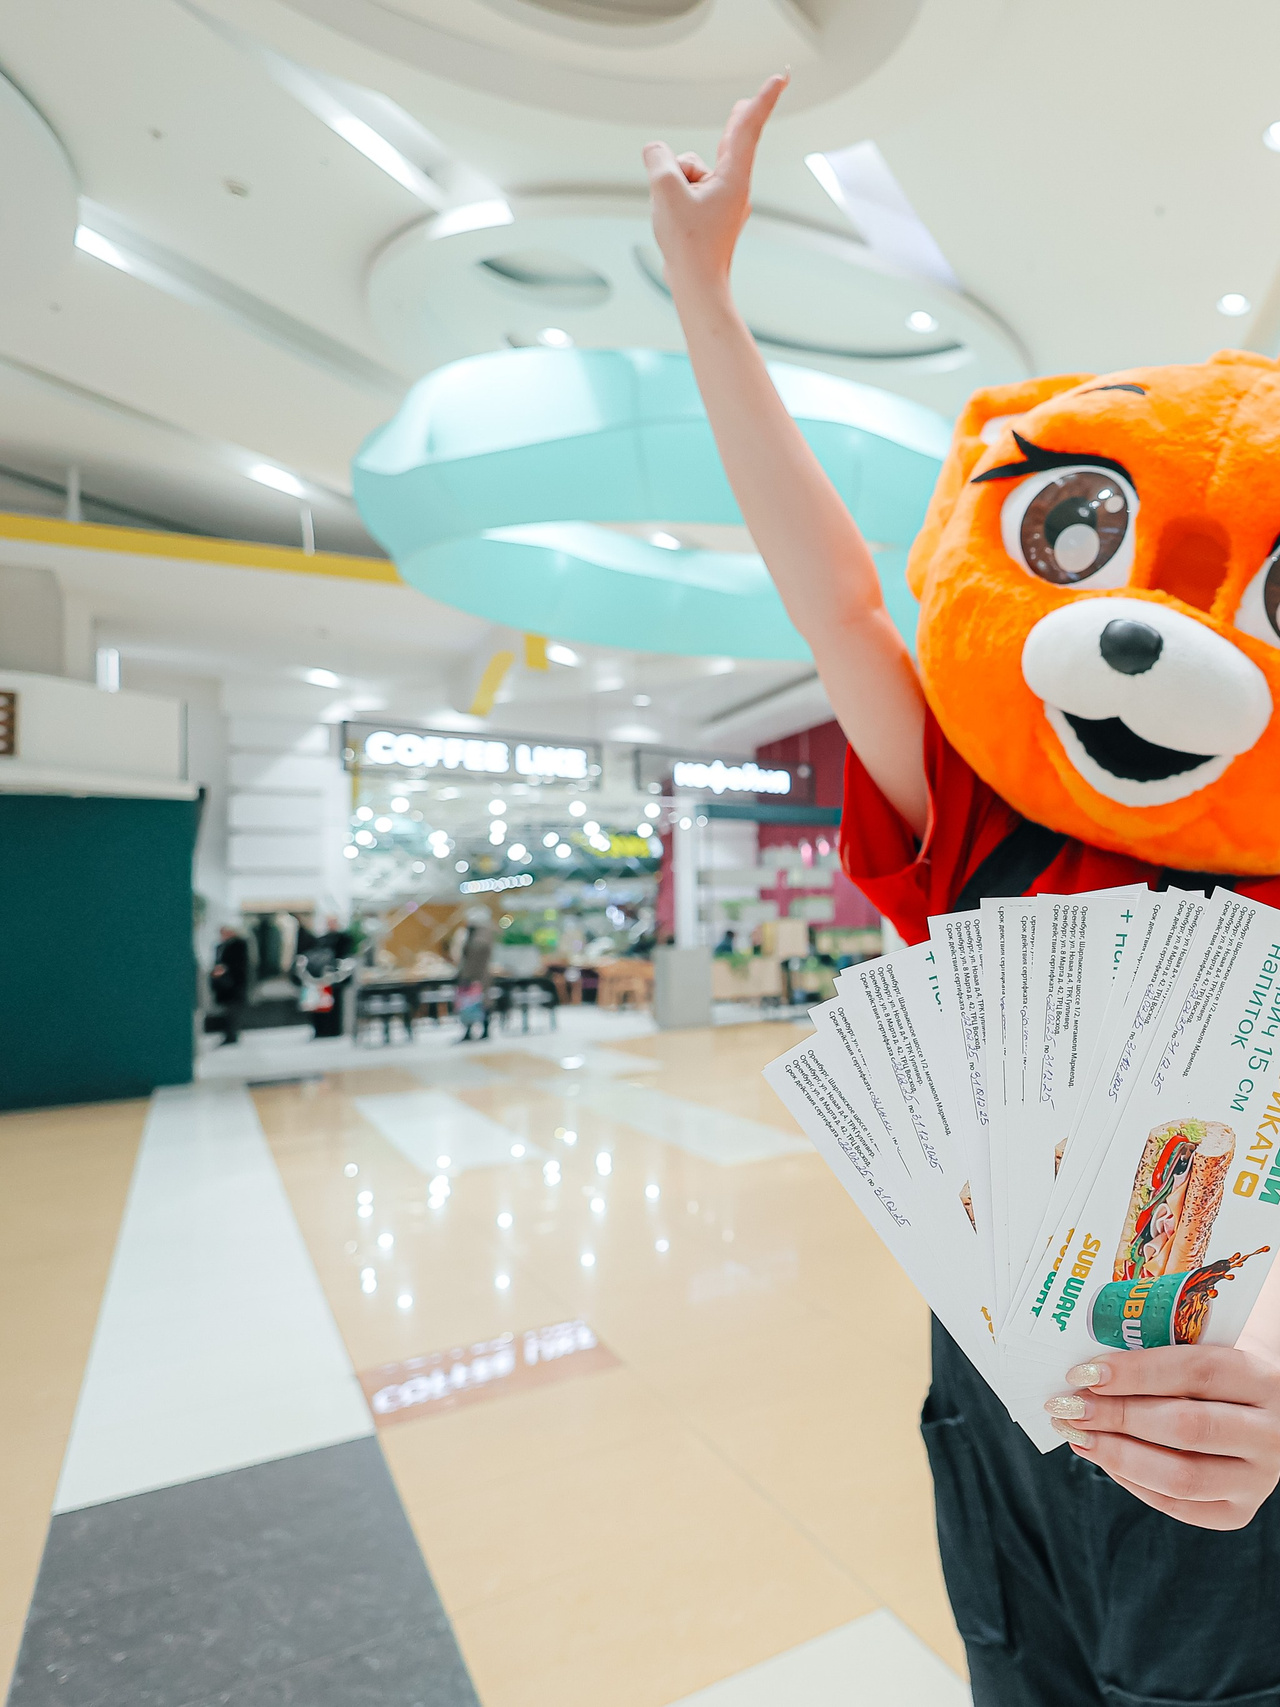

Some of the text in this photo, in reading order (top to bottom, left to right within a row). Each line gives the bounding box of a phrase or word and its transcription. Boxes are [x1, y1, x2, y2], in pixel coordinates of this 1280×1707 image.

[365, 730, 509, 773] COFFEE
[1051, 903, 1060, 921] Срок
[1059, 904, 1069, 939] Оренбург,
[1068, 905, 1078, 939] Оренбург,
[1078, 905, 1088, 940] Оренбург,
[1174, 898, 1187, 917] Срок
[1177, 901, 1195, 935] Оренбург,
[1185, 904, 1204, 938] Оренбург,
[1220, 899, 1232, 917] Срок
[1221, 902, 1240, 935] Оренбург,
[1229, 905, 1248, 938] Оренбург,
[945, 923, 954, 940] Срок
[1050, 922, 1058, 953] действия
[1163, 915, 1180, 946] действия
[1208, 916, 1225, 946] действия
[1237, 908, 1256, 941] Оренбург,
[948, 940, 960, 972] действия
[962, 920, 975, 954] Оренбург,
[971, 965, 980, 986] Новая
[977, 999, 985, 1012] ТРК
[1057, 956, 1065, 976] Марта
[1067, 951, 1075, 971] Новая
[1164, 950, 1177, 971] Марта
[1207, 949, 1221, 970] Марта
[1218, 947, 1230, 968] Новая
[953, 921, 966, 956] Оренбург,
[962, 972, 972, 993] Марта
[969, 1011, 977, 1025] ТРЦ
[1208, 979, 1218, 993] ТРК
[1055, 996, 1063, 1009] ТРЦ
[1152, 987, 1162, 1001] ТРЦ
[1195, 986, 1206, 1000] ТРЦ
[1213, 980, 1225, 1001] шоссе
[866, 969, 885, 1003] Оренбург,
[885, 1018, 898, 1039] Марта
[899, 1055, 909, 1069] ТРЦ
[875, 966, 893, 999] Оренбург,
[892, 1009, 904, 1030] Новая
[904, 1041, 914, 1055] ТРК
[827, 1010, 855, 1056] Срок действия
[858, 971, 870, 989] Срок
[865, 989, 881, 1020] действия
[907, 1104, 915, 1113] по
[884, 962, 902, 996] Оренбург,
[912, 1037, 923, 1058] шоссе
[924, 1070, 939, 1101] мегамолл
[1071, 1019, 1079, 1051] мегамолл
[1128, 1031, 1135, 1040] по
[1171, 1029, 1178, 1038] по
[1196, 1013, 1212, 1043] мегамолл
[805, 1048, 831, 1080] Оренбург,
[1044, 1044, 1049, 1053] по
[1248, 1046, 1274, 1073] 15
[968, 1061, 975, 1070] по
[790, 1058, 816, 1090] Оренбург,
[820, 1100, 838, 1120] Марта
[845, 1132, 857, 1147] ТРЦ
[797, 1053, 823, 1085] Оренбург,
[825, 1091, 841, 1110] Новая
[846, 1118, 858, 1132] ТРК
[1230, 1078, 1254, 1112] см
[783, 1062, 798, 1080] Срок
[793, 1078, 817, 1106] действия
[866, 1177, 875, 1187] по
[1051, 1233, 1102, 1332] SUBWAY
